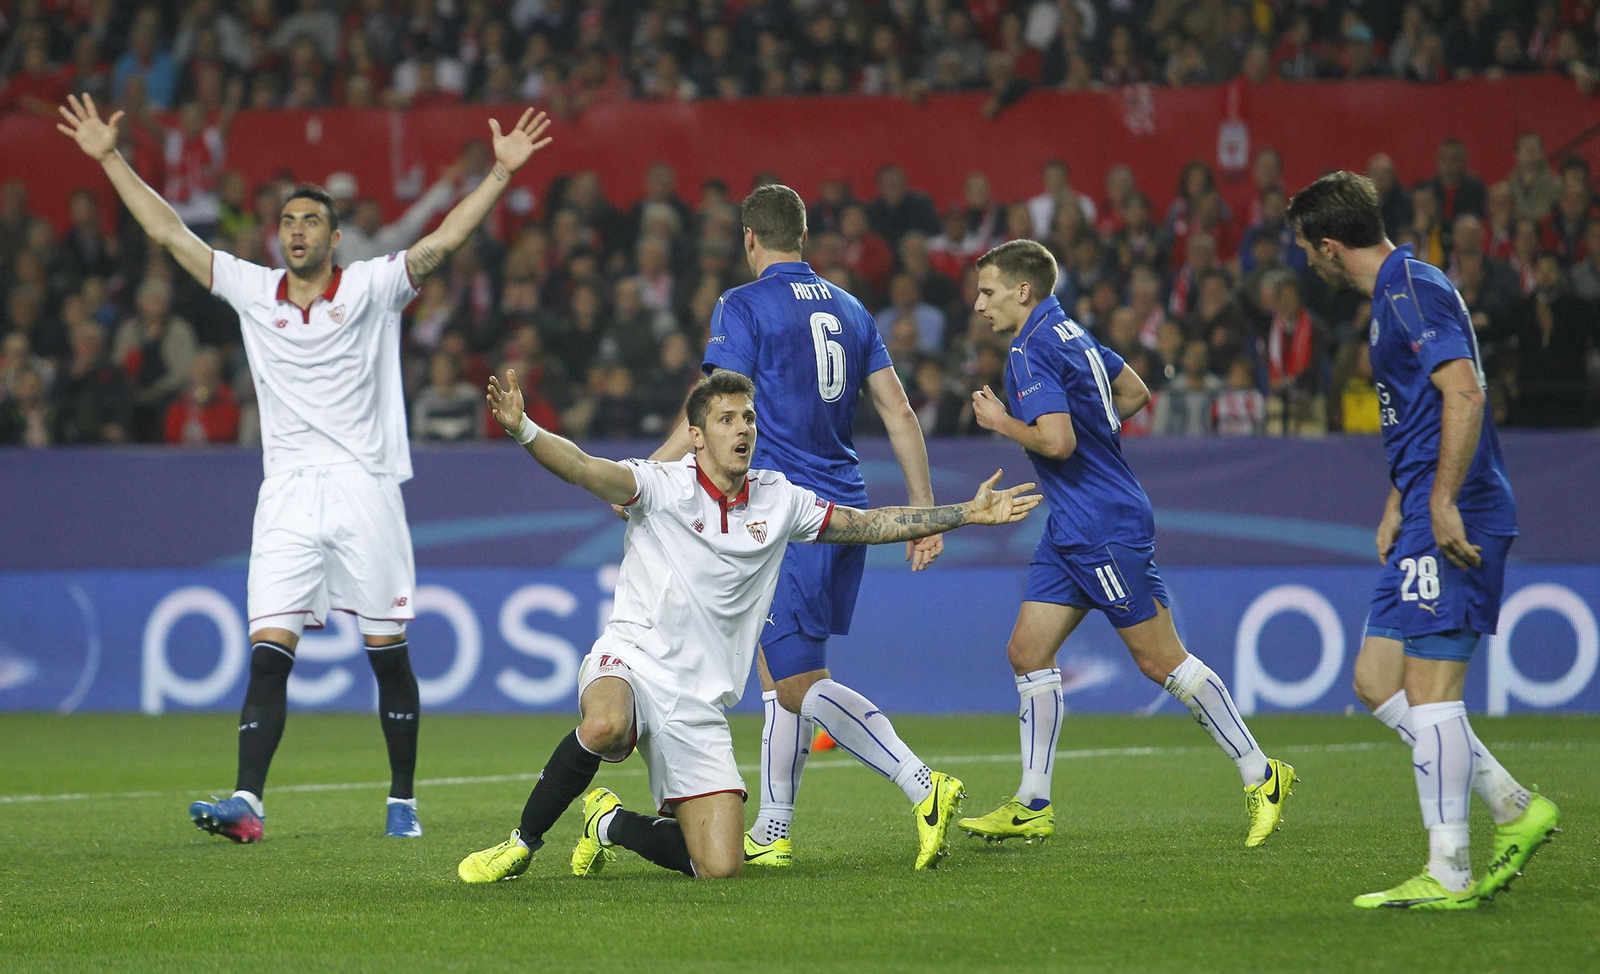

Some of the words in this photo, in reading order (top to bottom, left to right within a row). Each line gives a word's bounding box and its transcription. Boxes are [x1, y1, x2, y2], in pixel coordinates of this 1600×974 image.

[790, 282, 832, 300] HUTH
[809, 311, 846, 403] 6
[1021, 382, 1043, 397] RESPECT
[1094, 564, 1126, 602] 11
[1400, 555, 1440, 602] 28
[1234, 583, 1600, 717] pp
